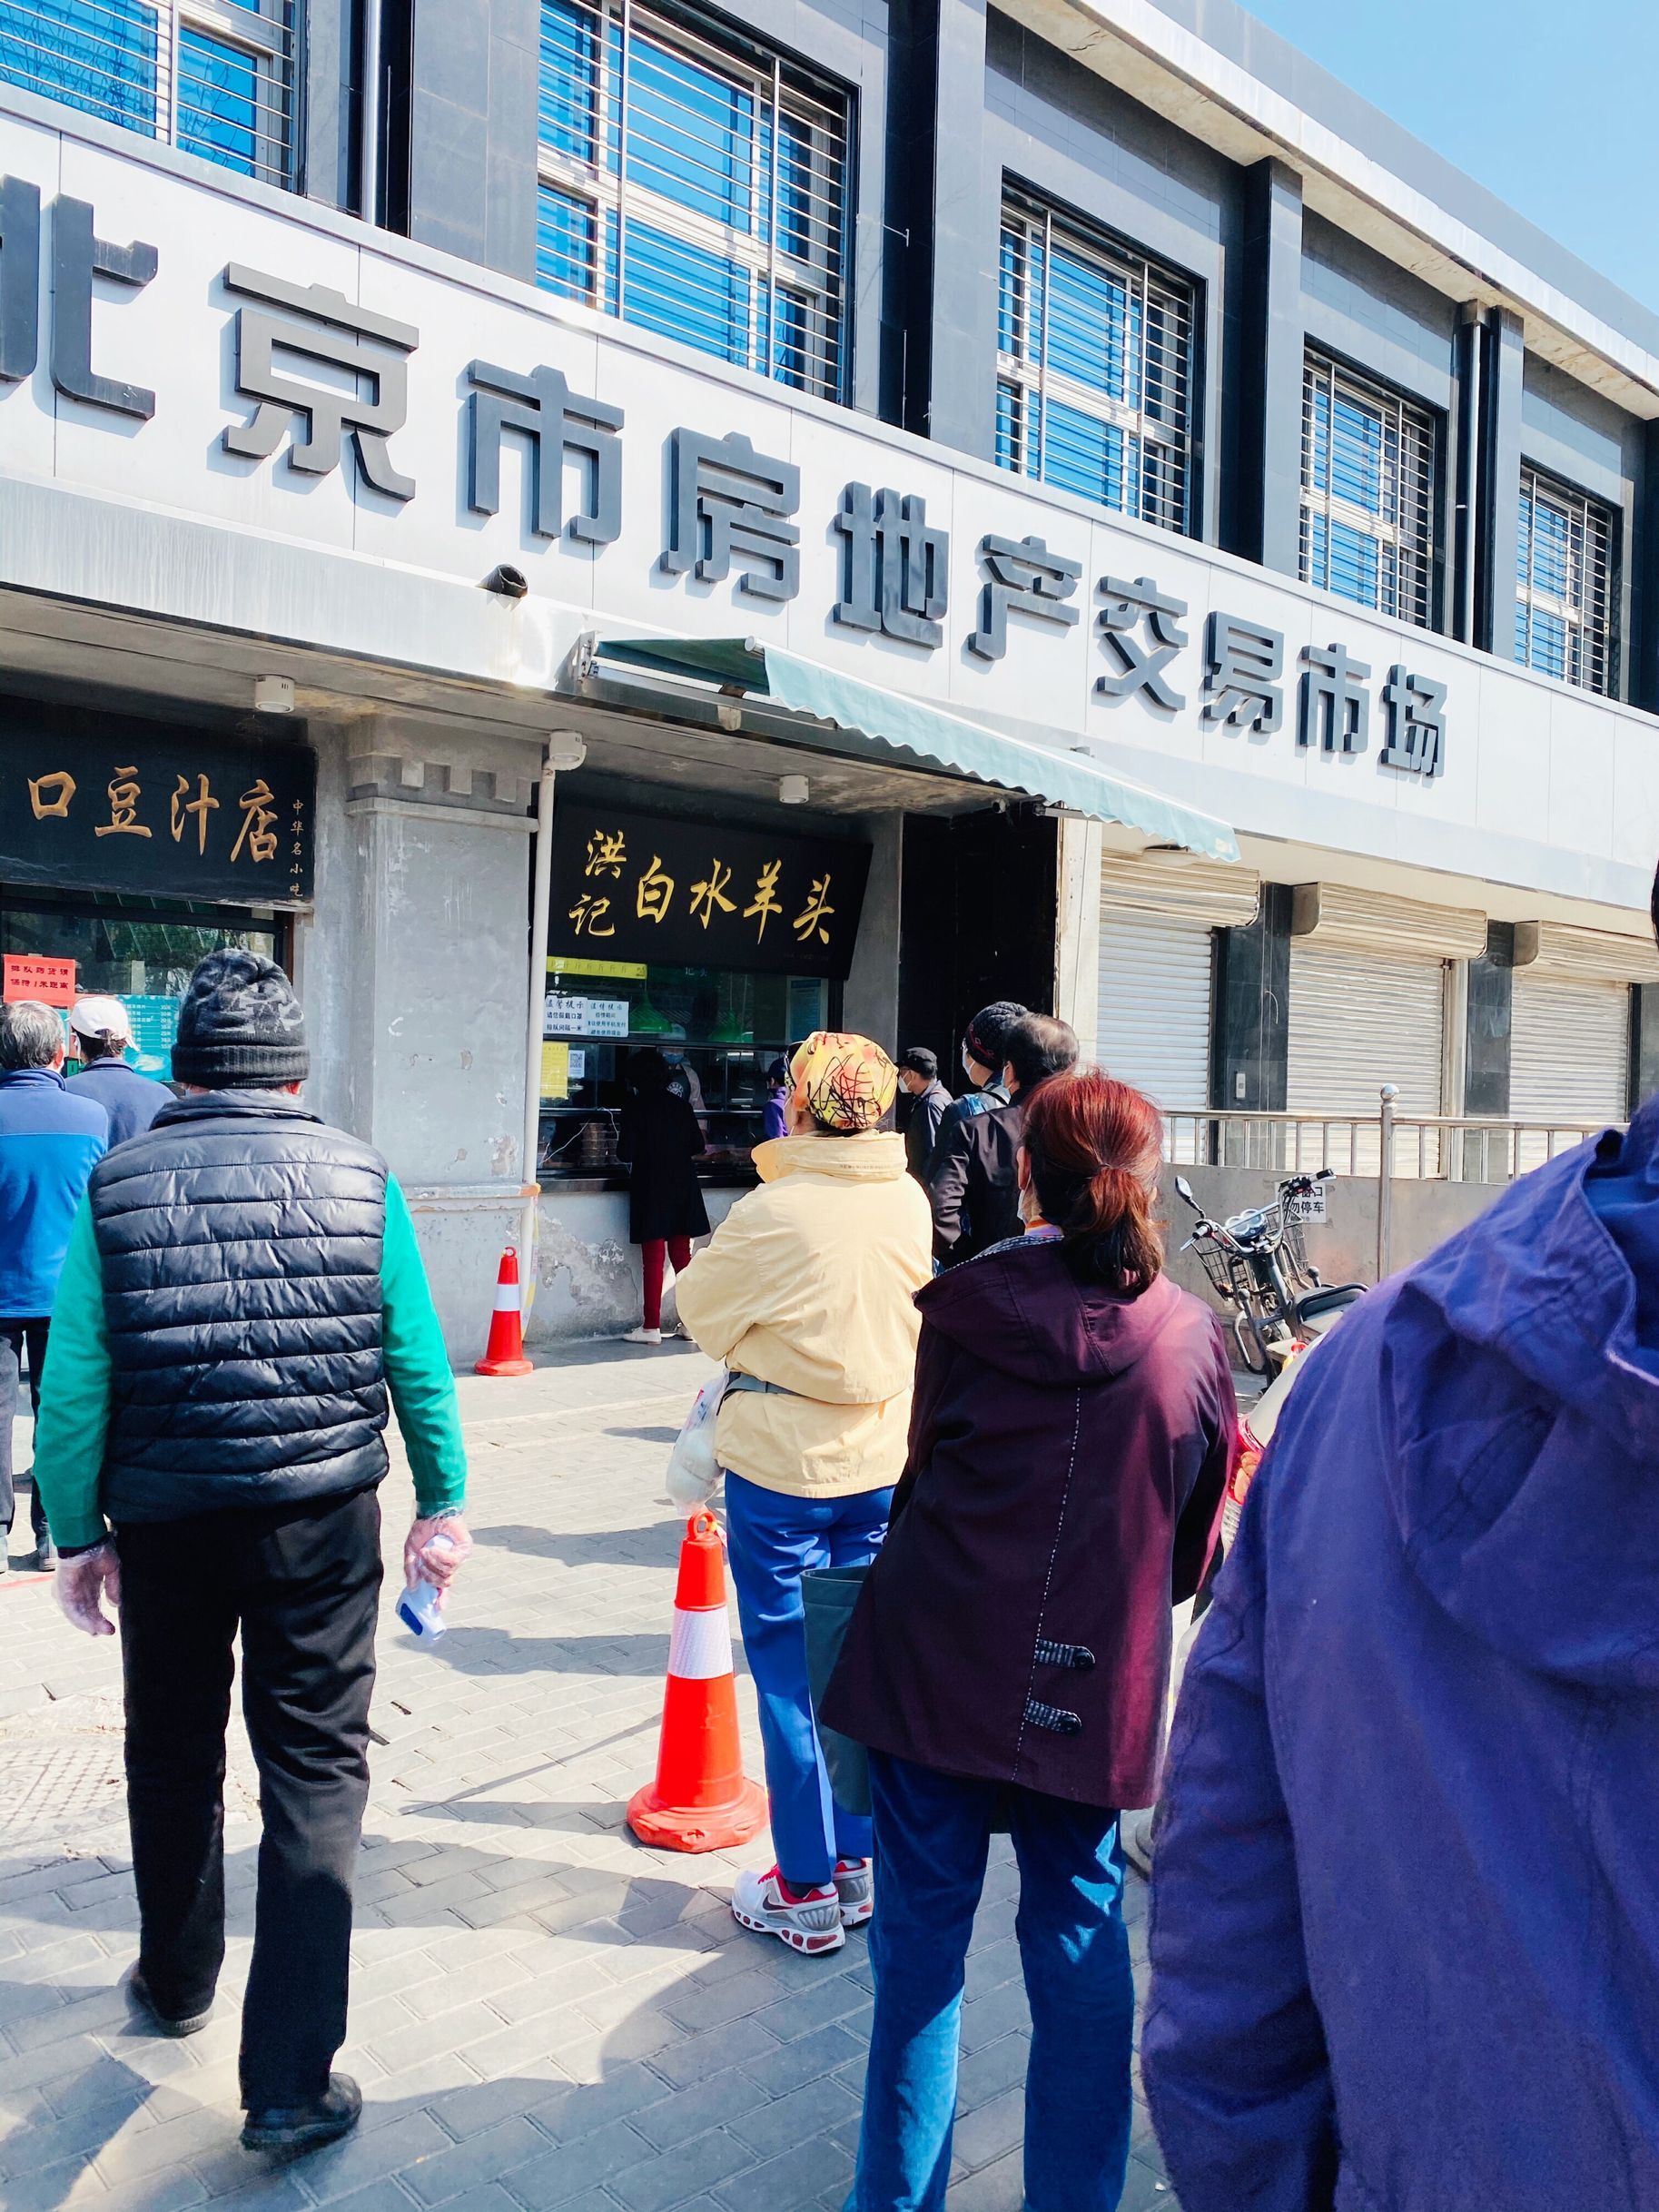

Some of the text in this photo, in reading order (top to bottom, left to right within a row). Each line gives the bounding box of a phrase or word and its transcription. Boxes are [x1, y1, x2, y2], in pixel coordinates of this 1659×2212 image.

[0, 173, 1447, 778] 北京市房地产交易市场
[27, 765, 279, 863] 口豆汁店
[290, 799, 304, 897] 中华名小吃
[568, 829, 627, 937] 洪记
[637, 854, 835, 945] 白水羊头
[1283, 1200, 1325, 1214] 勿停车
